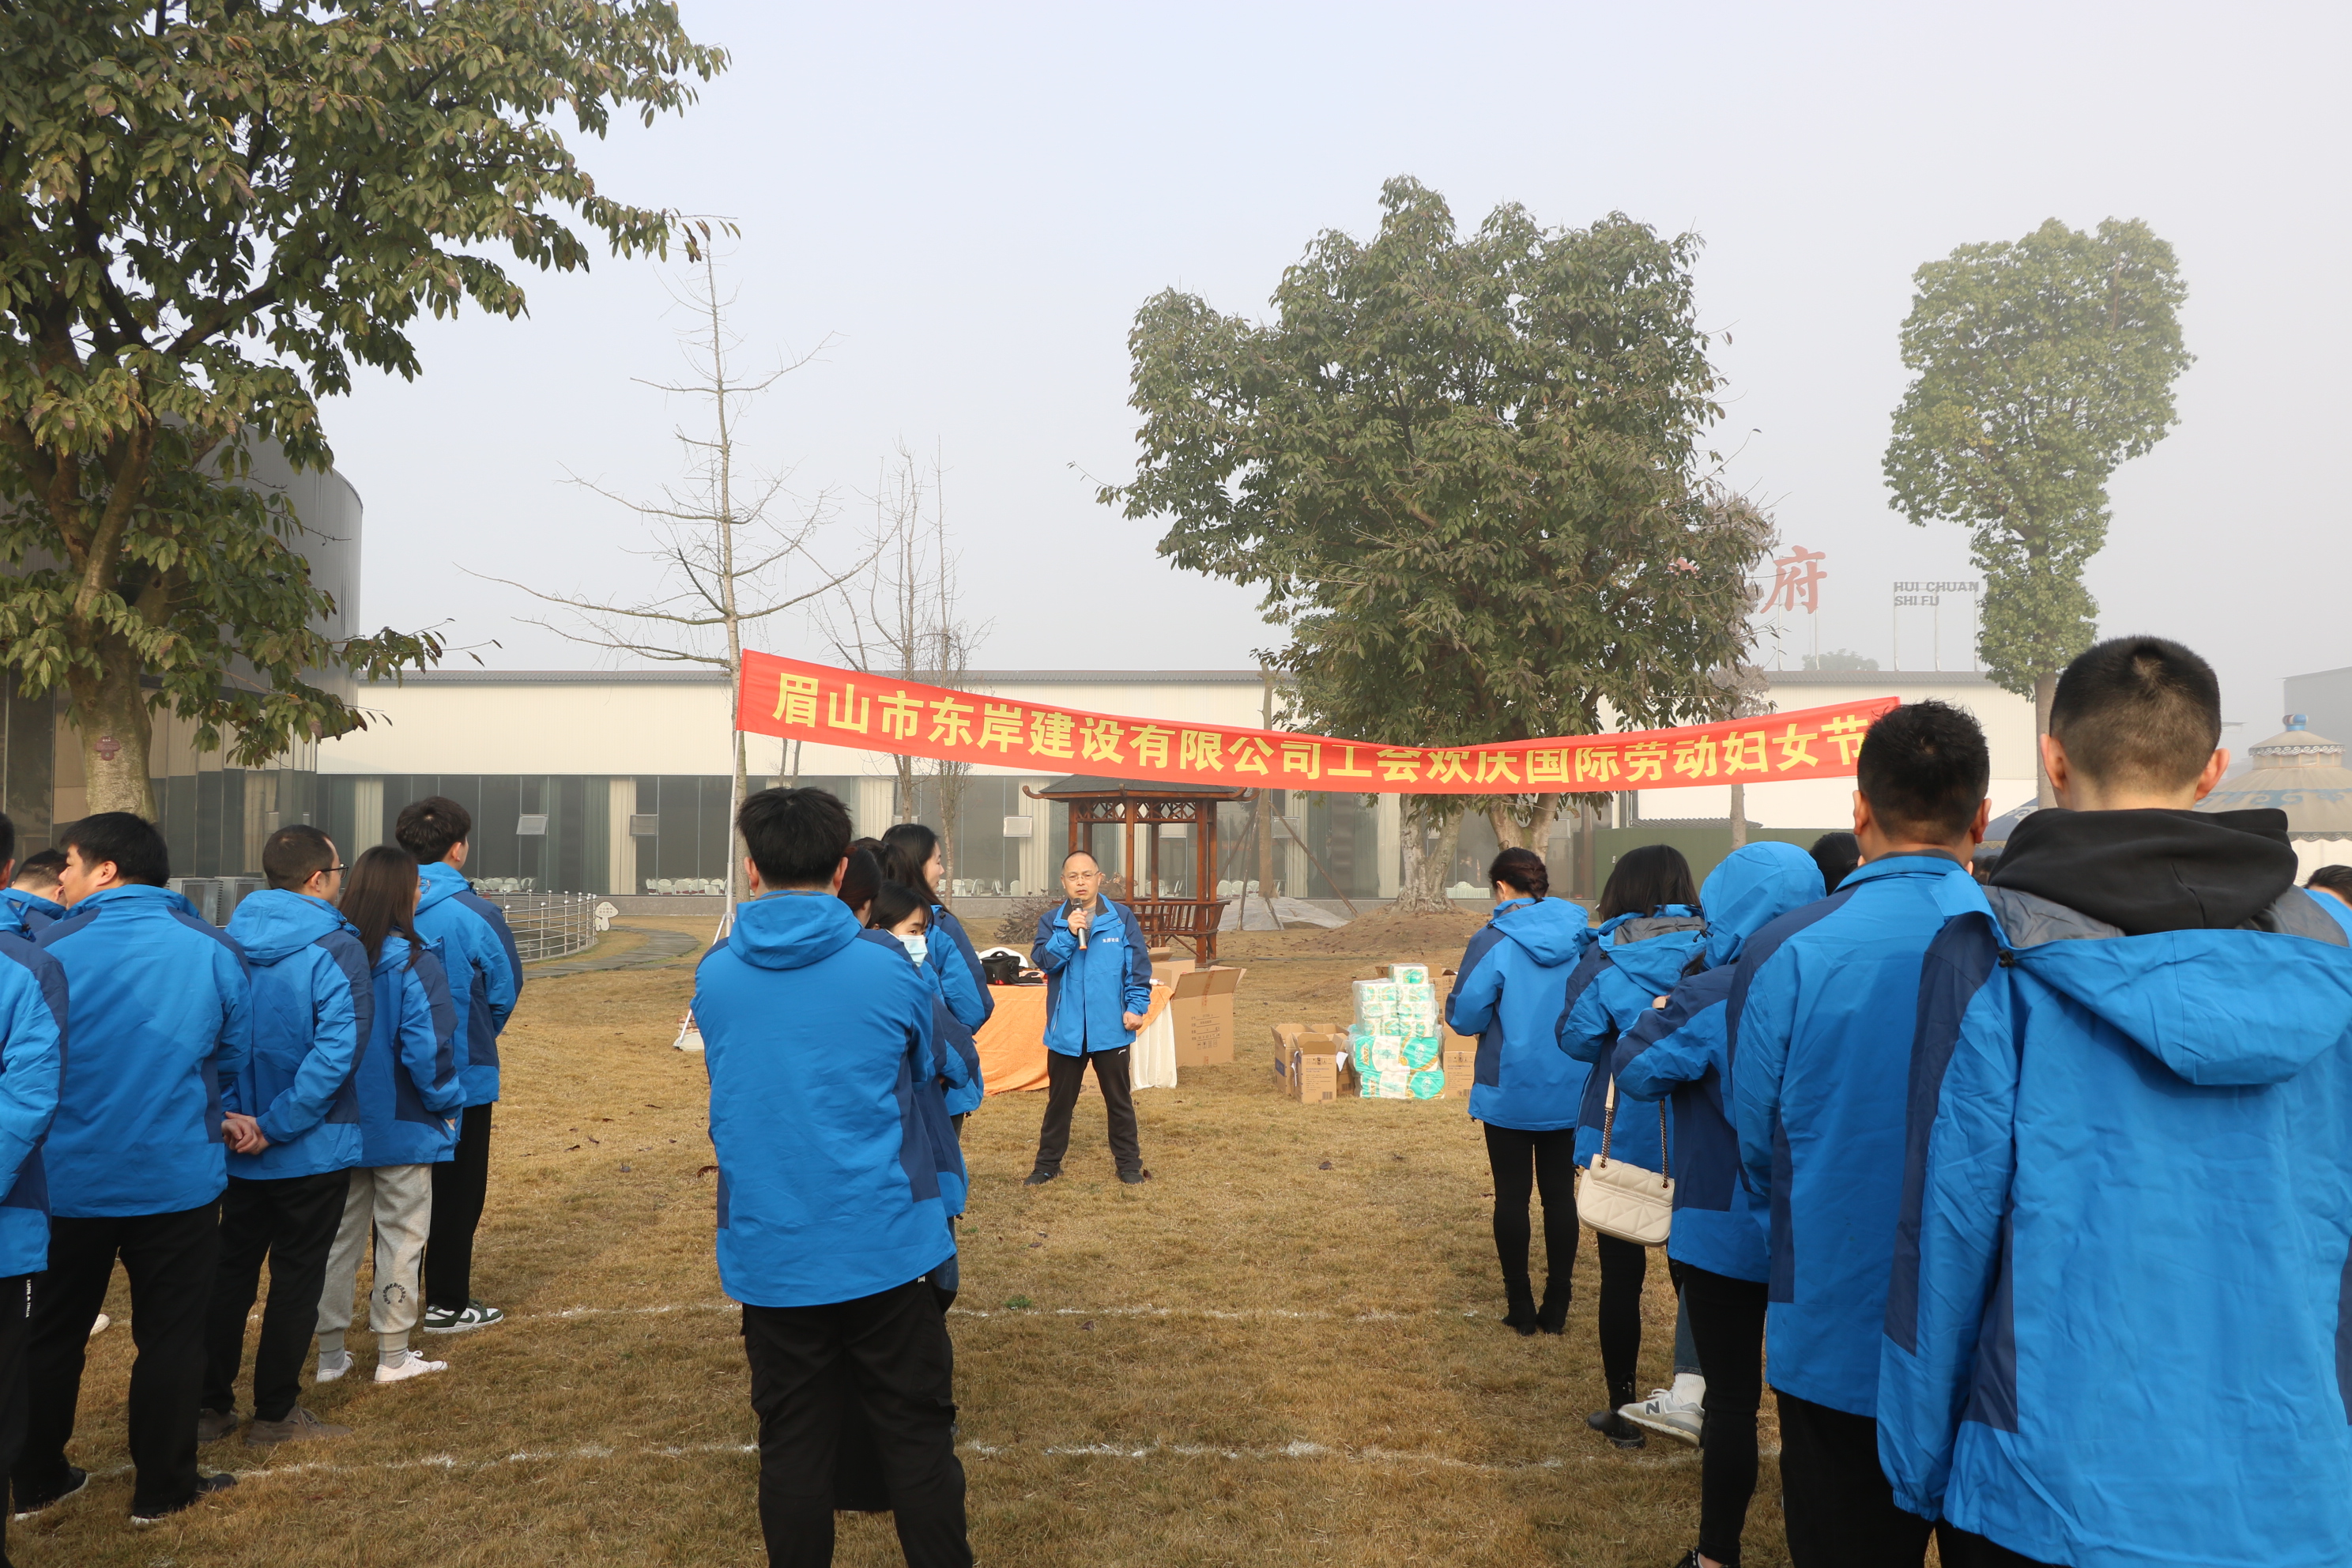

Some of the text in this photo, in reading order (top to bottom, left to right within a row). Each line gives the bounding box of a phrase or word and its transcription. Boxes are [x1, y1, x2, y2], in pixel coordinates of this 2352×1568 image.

[1760, 545, 1827, 614] 府
[1894, 582, 1980, 593] HUI CHUAN
[772, 673, 1868, 785] 眉山市东岸建设有限公司工会欢庆国际劳动妇女节
[1645, 1400, 1660, 1415] N
